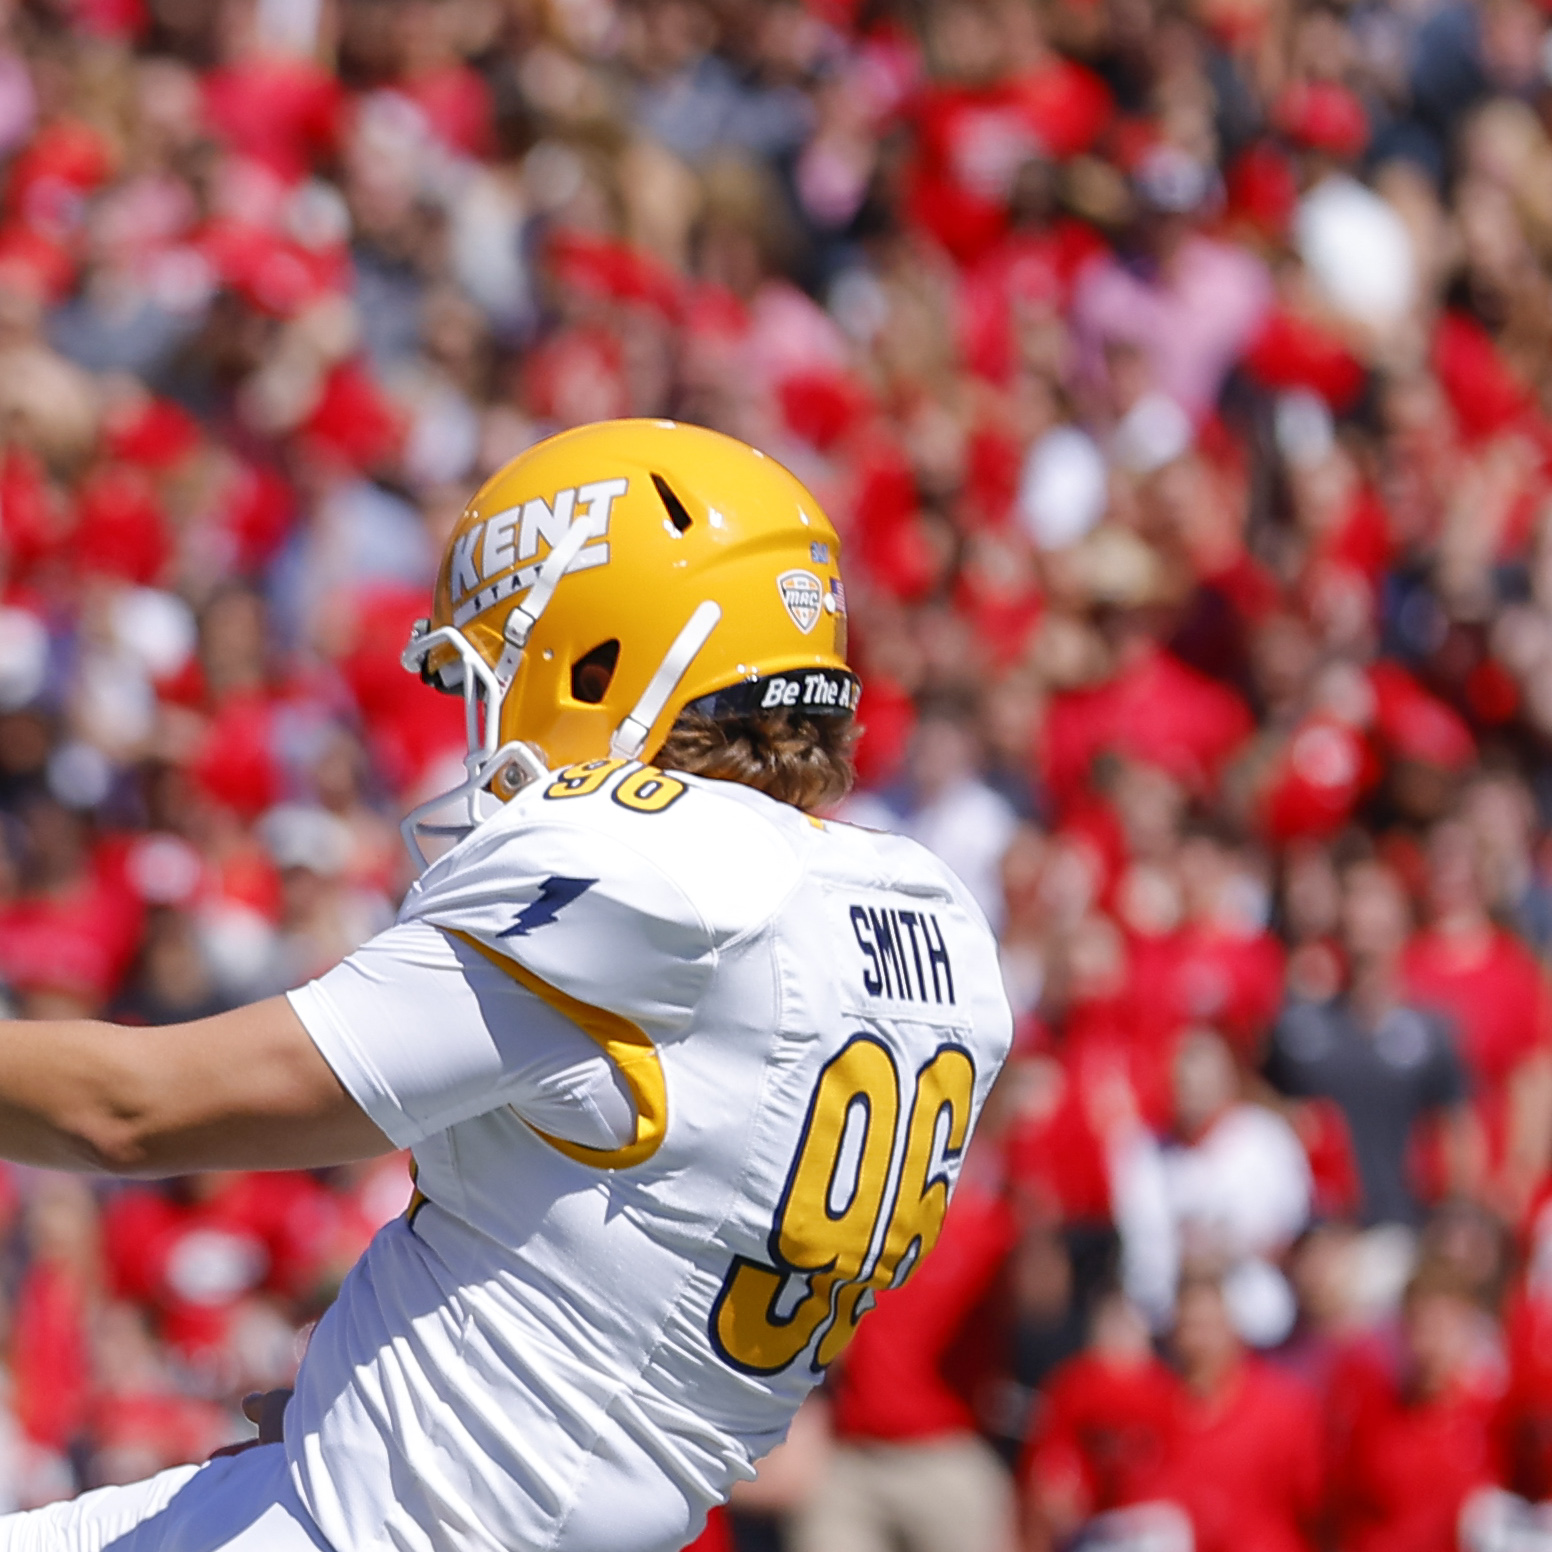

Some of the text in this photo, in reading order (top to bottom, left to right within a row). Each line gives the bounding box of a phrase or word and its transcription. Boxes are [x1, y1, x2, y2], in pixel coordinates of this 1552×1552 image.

[451, 477, 630, 604] KENT
[761, 678, 801, 708] Be
[802, 673, 839, 705] The
[543, 758, 689, 813] 96
[849, 904, 956, 1006] SMITH
[707, 1031, 979, 1378] 96
